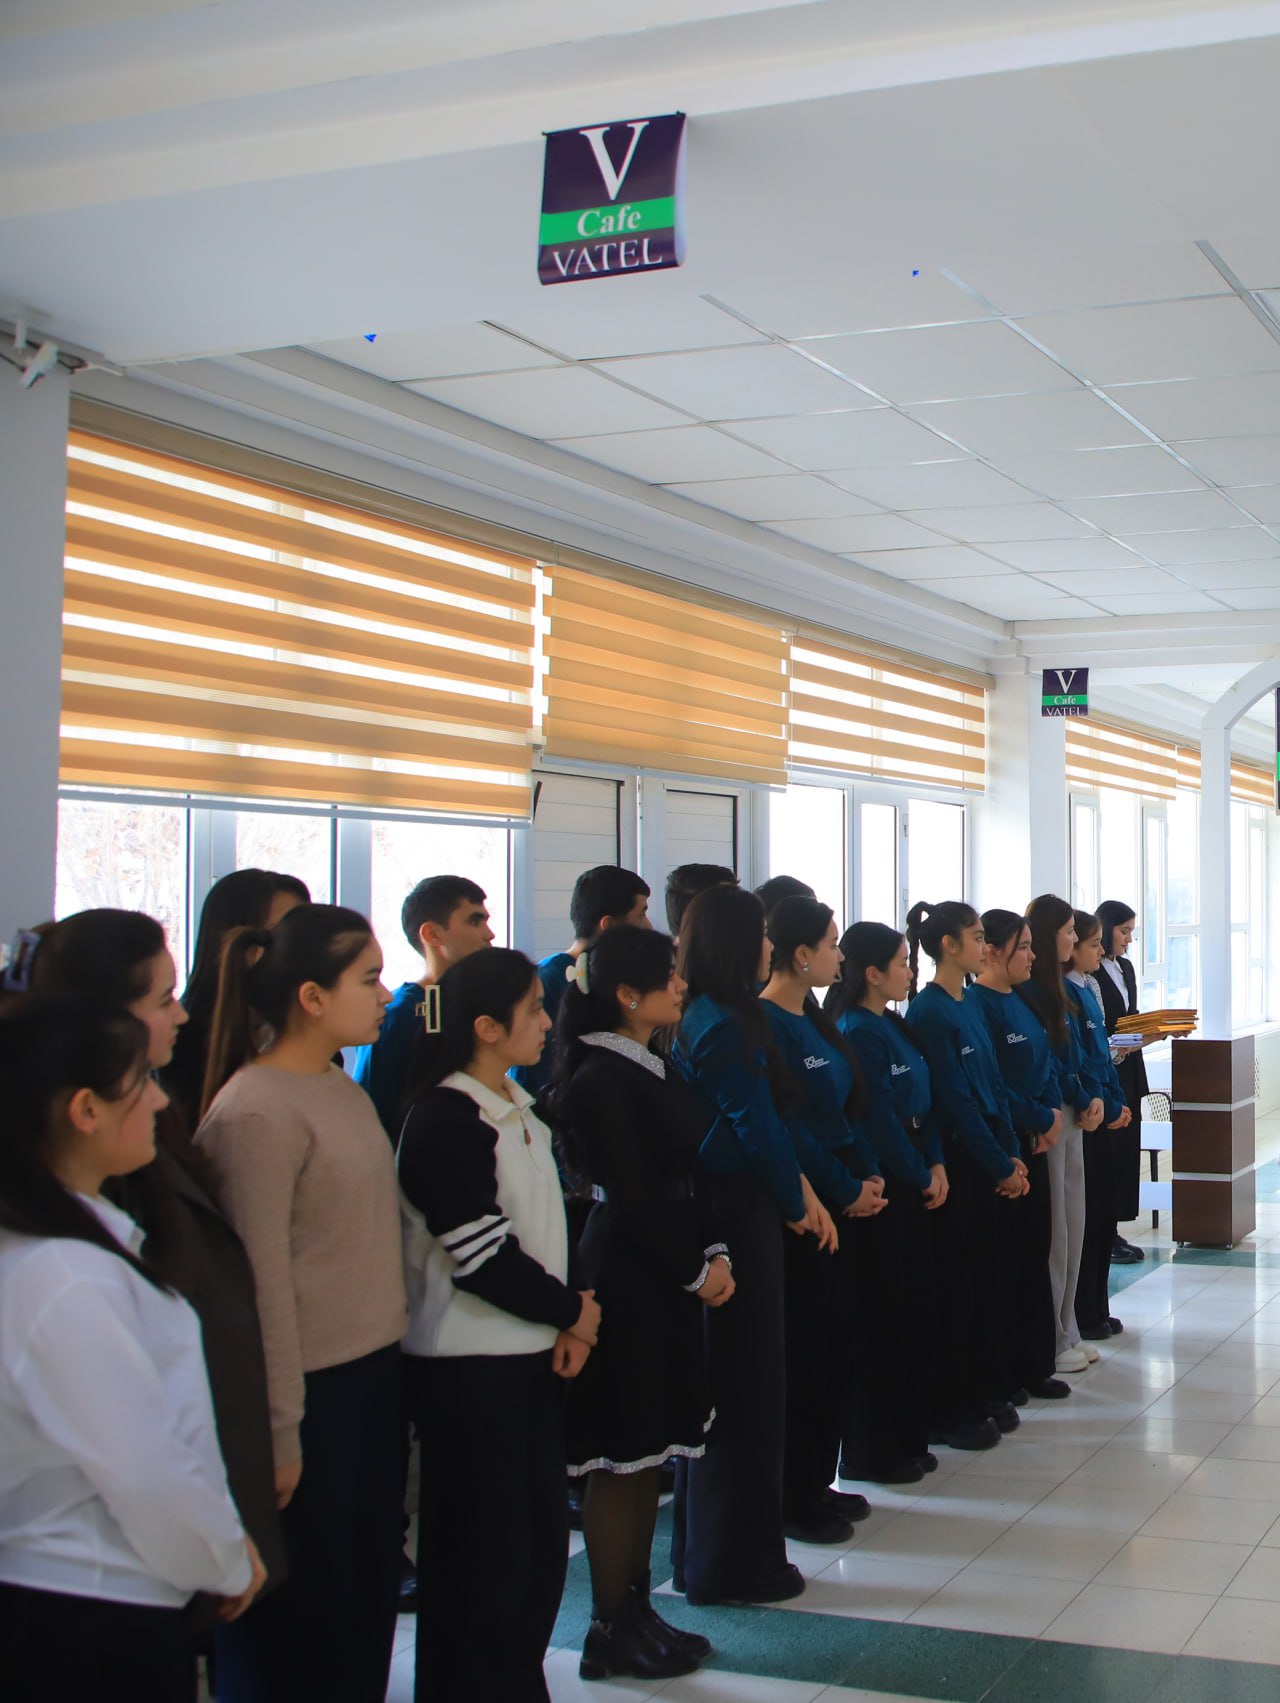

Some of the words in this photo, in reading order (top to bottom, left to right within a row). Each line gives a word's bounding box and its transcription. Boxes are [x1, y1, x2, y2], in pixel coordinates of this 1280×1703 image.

[579, 120, 651, 201] V
[577, 204, 641, 237] Cafe
[553, 237, 663, 277] VATEL
[1054, 669, 1078, 694] V
[1046, 706, 1084, 716] VATEL
[1054, 695, 1076, 705] Cafe
